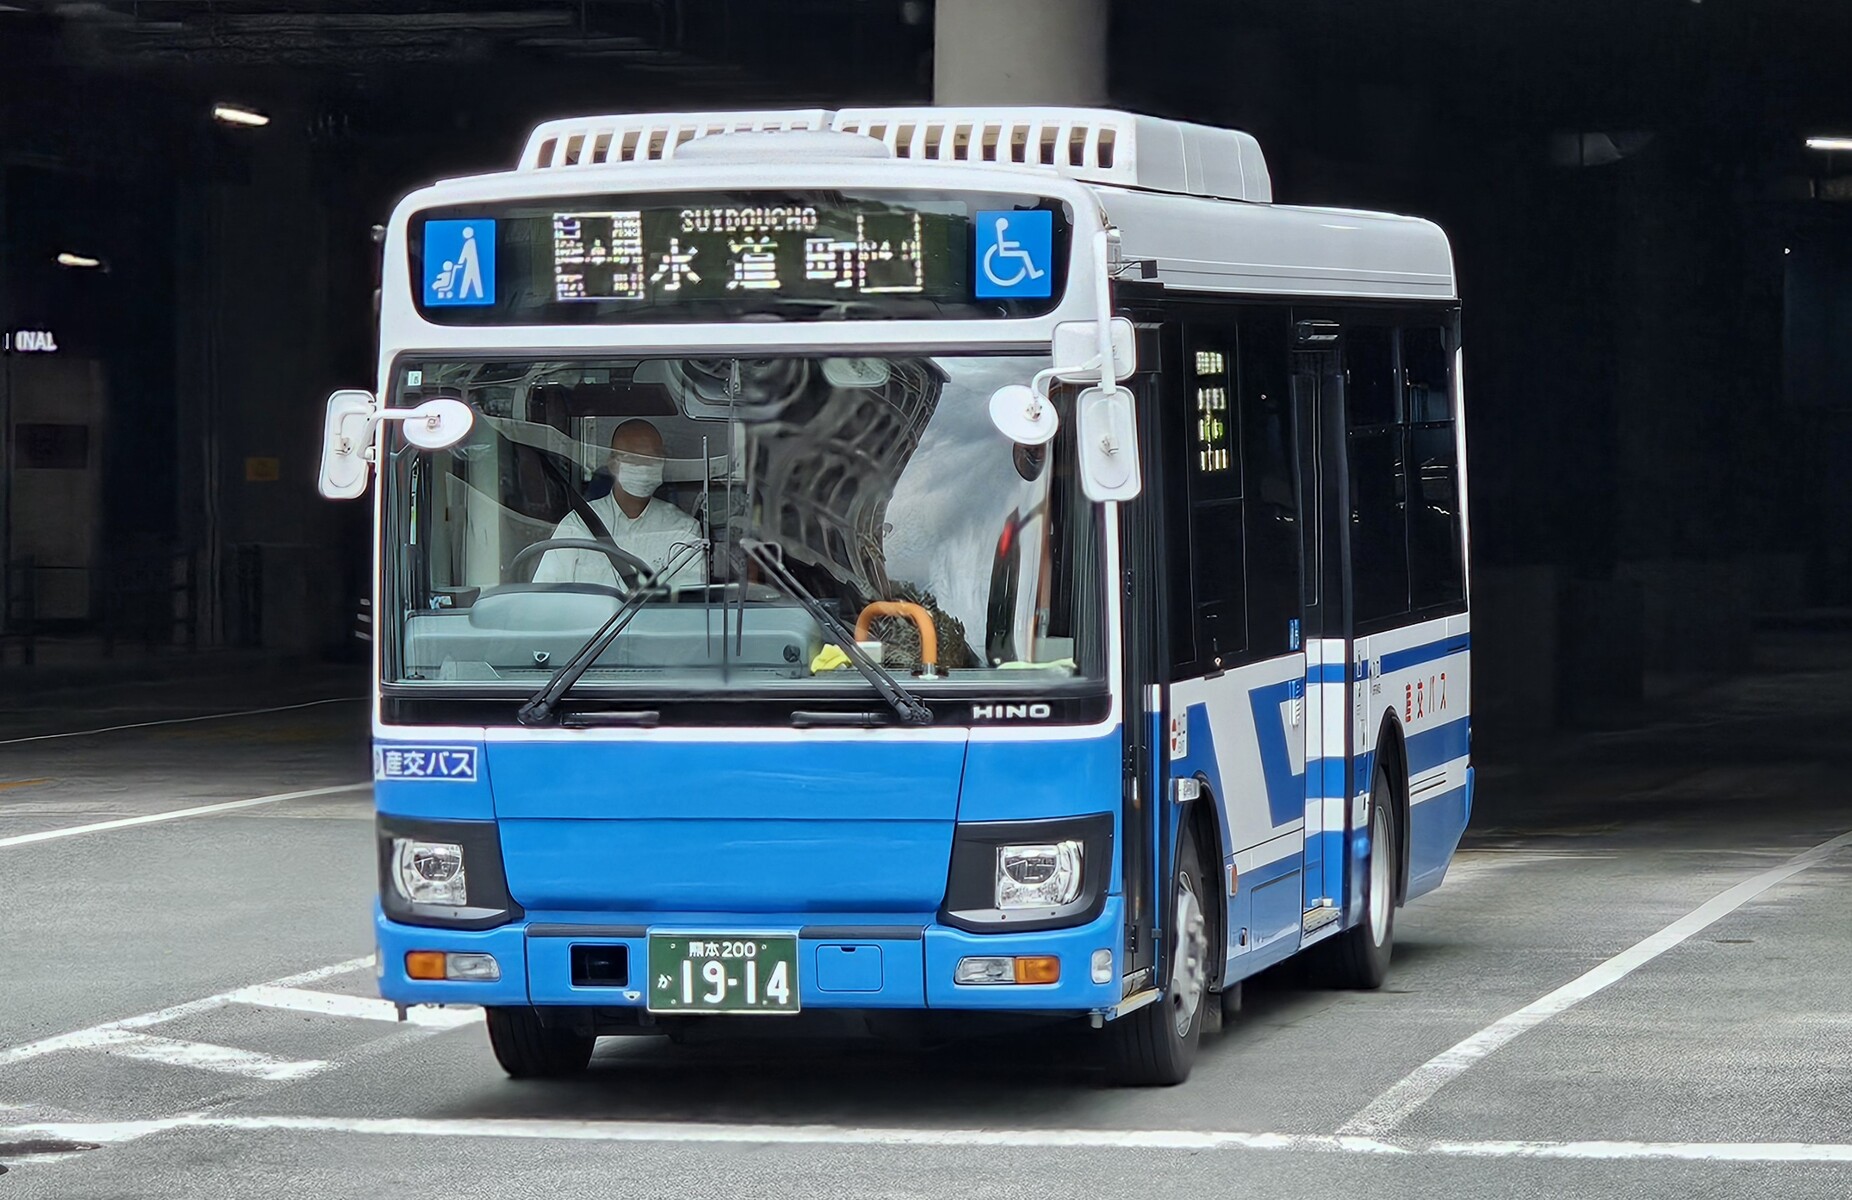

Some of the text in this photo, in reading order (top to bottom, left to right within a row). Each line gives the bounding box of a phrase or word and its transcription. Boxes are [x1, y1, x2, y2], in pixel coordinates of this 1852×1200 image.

[650, 235, 857, 290] 水道町
[5, 330, 58, 351] INAL
[973, 704, 1051, 719] HINO
[385, 750, 473, 776] 産交バス
[657, 959, 790, 1005] か 19-14
